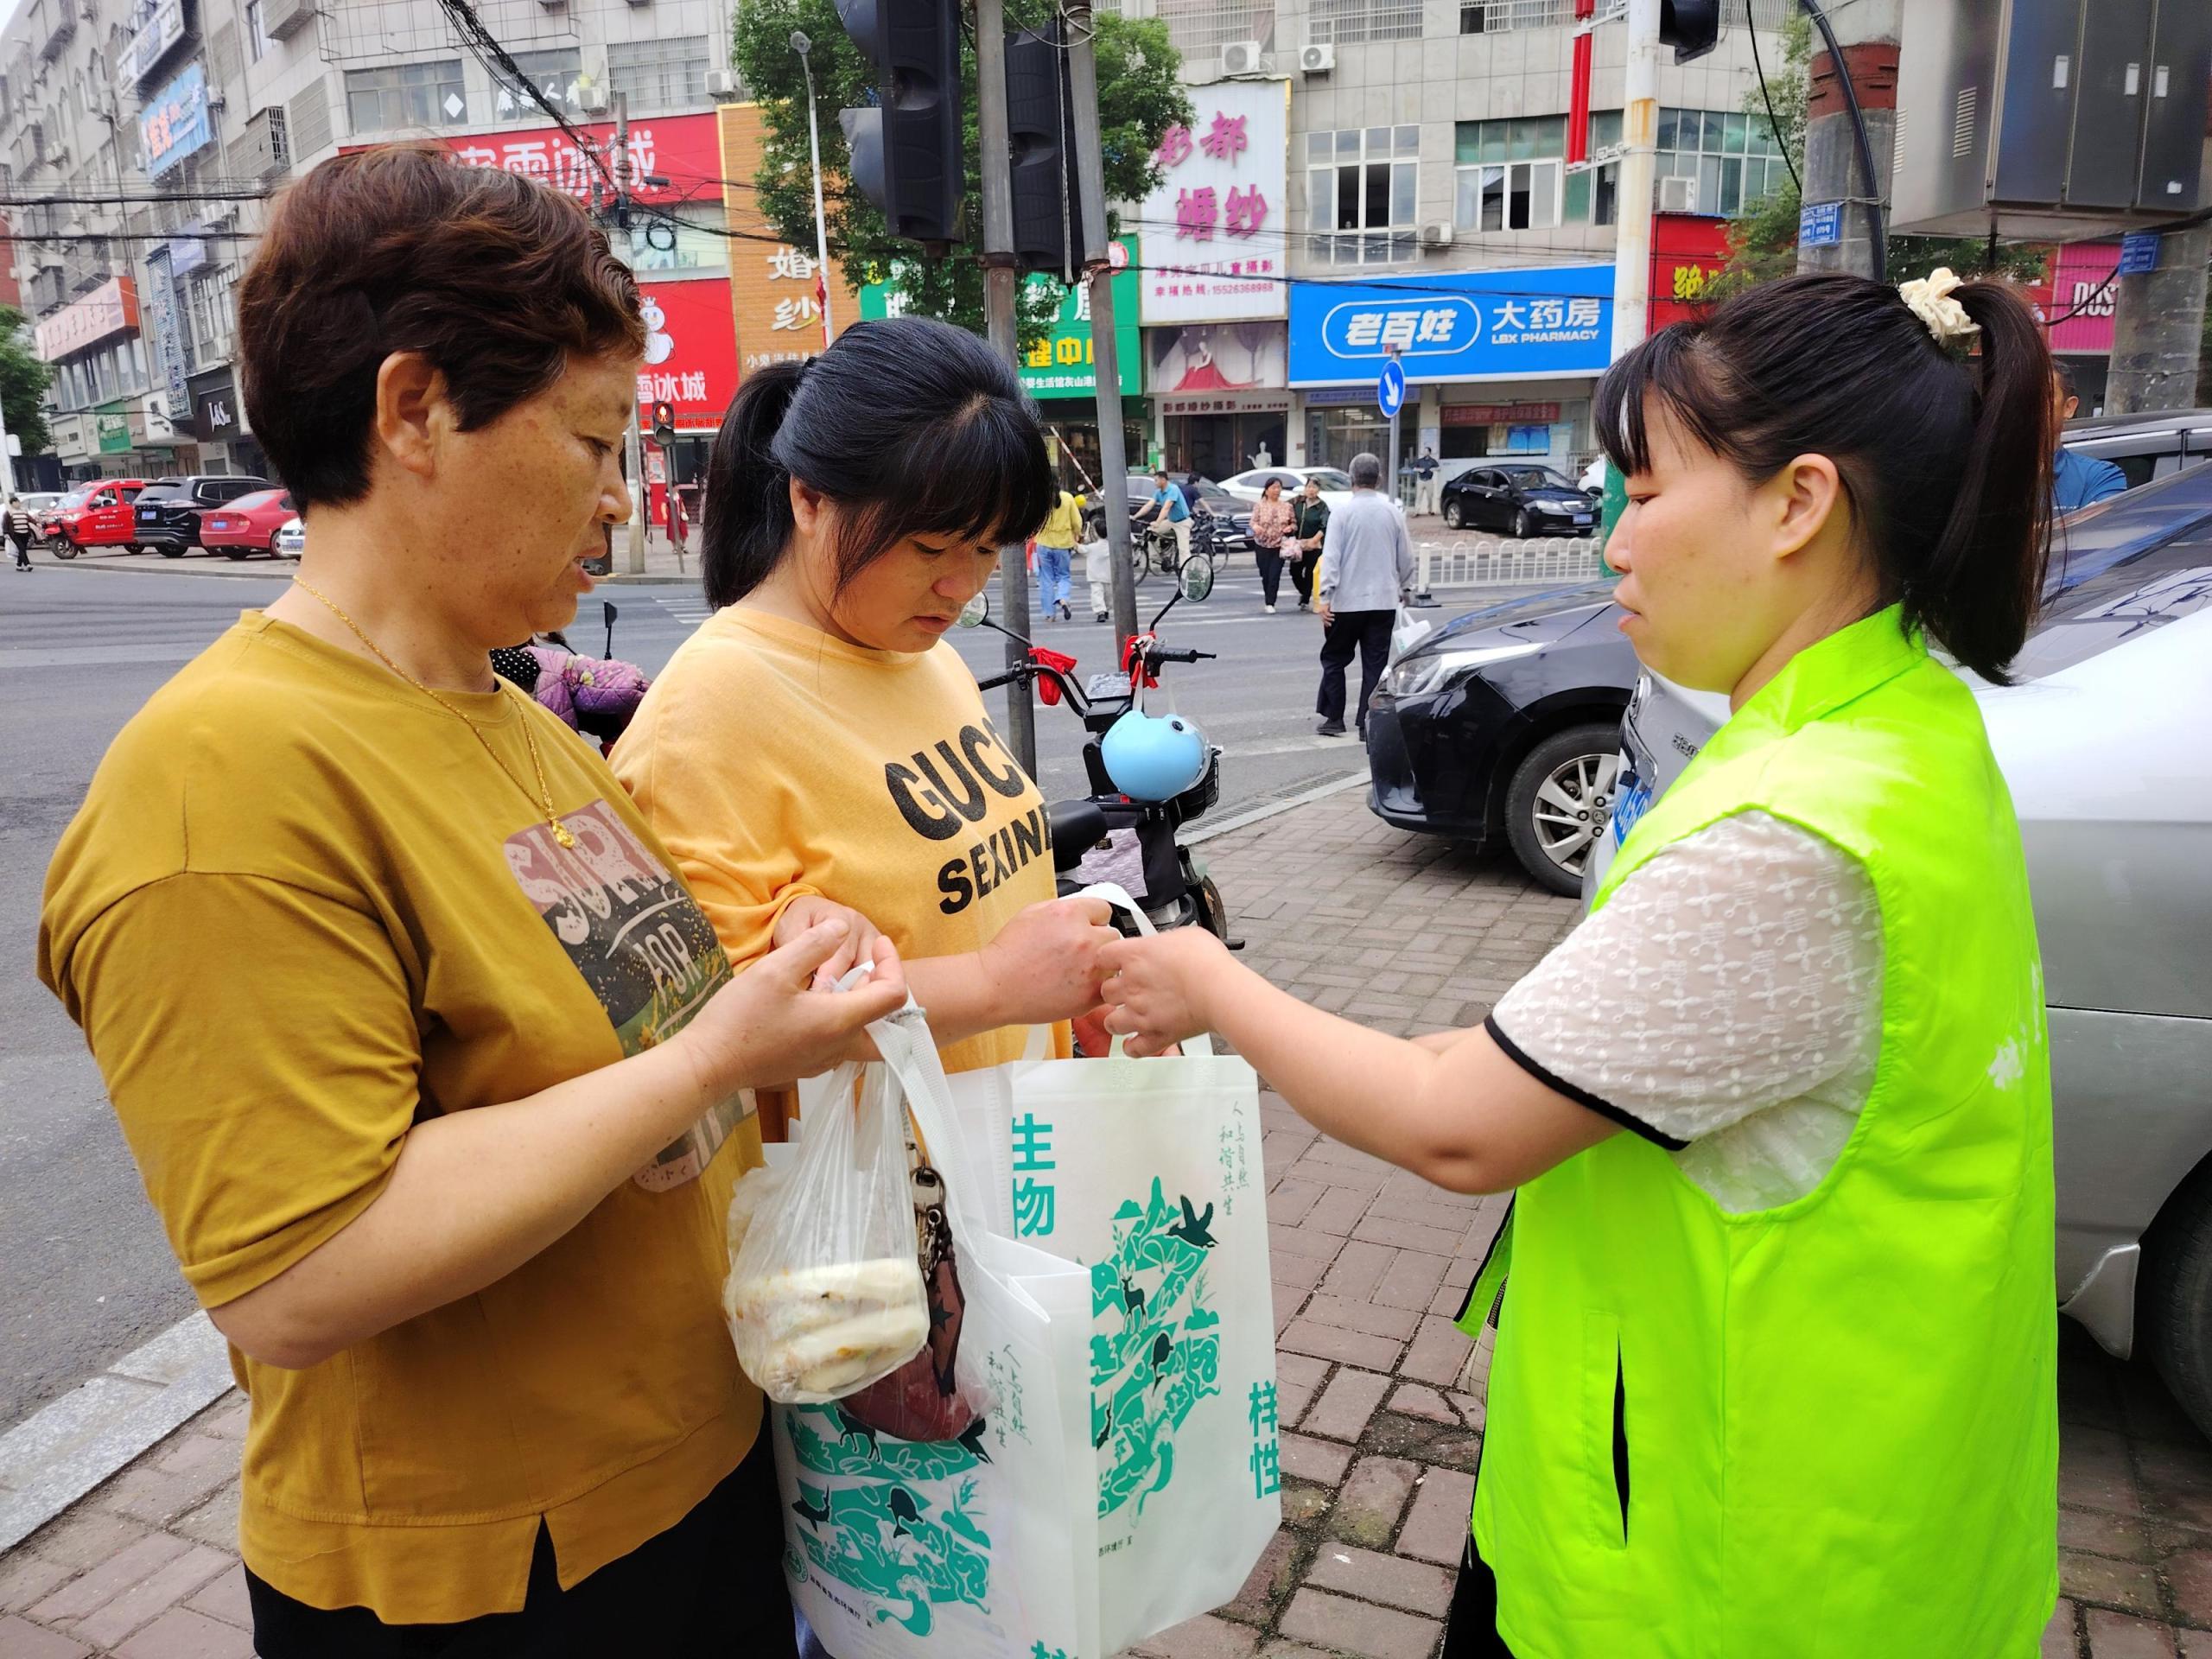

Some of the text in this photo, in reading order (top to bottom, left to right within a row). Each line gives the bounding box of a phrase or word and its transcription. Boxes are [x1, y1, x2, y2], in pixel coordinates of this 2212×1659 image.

[1175, 184, 1268, 242] 婚纱
[1492, 299, 1601, 331] 大药房
[2074, 282, 2120, 316] DUS
[1345, 309, 1458, 351] 老百姓
[1492, 329, 1599, 345] LBX PHARMACY
[638, 371, 707, 404] 雪冰城
[1012, 1113, 1056, 1239] 生物
[1249, 1380, 1281, 1499] 样性
